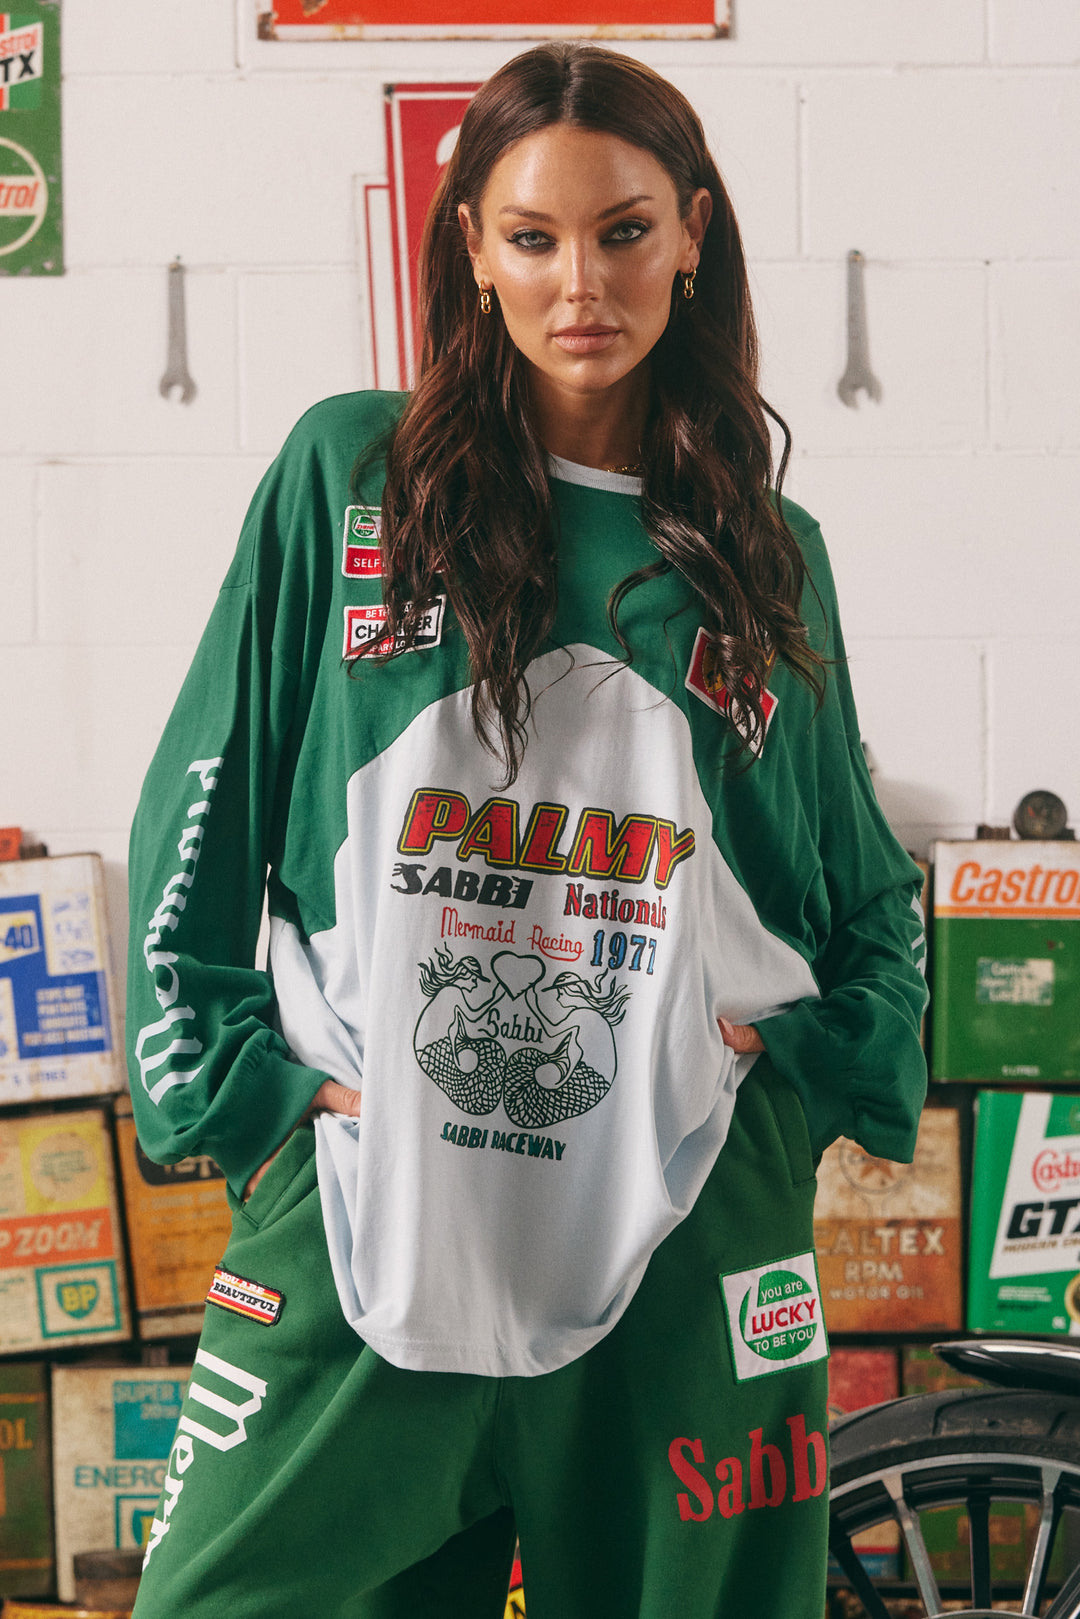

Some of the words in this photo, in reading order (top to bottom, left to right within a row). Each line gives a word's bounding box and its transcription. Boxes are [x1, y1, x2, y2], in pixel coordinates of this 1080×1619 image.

[0, 181, 39, 208] rol
[353, 557, 380, 568] SELF
[355, 615, 432, 639] CHER
[366, 610, 376, 619] BE
[397, 787, 695, 890] PALMY
[391, 862, 534, 909] SABBI
[950, 861, 1080, 904] Castro
[564, 883, 667, 931] Nationals
[5, 925, 33, 949] 40
[440, 907, 516, 944] Mermaid
[527, 924, 584, 962] Racing
[590, 929, 657, 976] 1977
[478, 1008, 543, 1044] Sabbi
[440, 1122, 489, 1149] SABBI
[491, 1130, 567, 1161] RACEWAY
[14, 1218, 105, 1257] ZOOM
[220, 1271, 240, 1286] YOU
[239, 1281, 265, 1296] ARE
[845, 1260, 904, 1283] RPM
[61, 1284, 97, 1311] BP
[214, 1282, 277, 1313] BEAUTIFUL
[761, 1284, 783, 1304] you
[784, 1280, 803, 1294] are
[751, 1298, 817, 1335] LUCKY
[753, 1340, 770, 1354] TO
[773, 1334, 787, 1348] BE
[788, 1327, 814, 1344] YOU
[667, 1411, 828, 1522] Sabb
